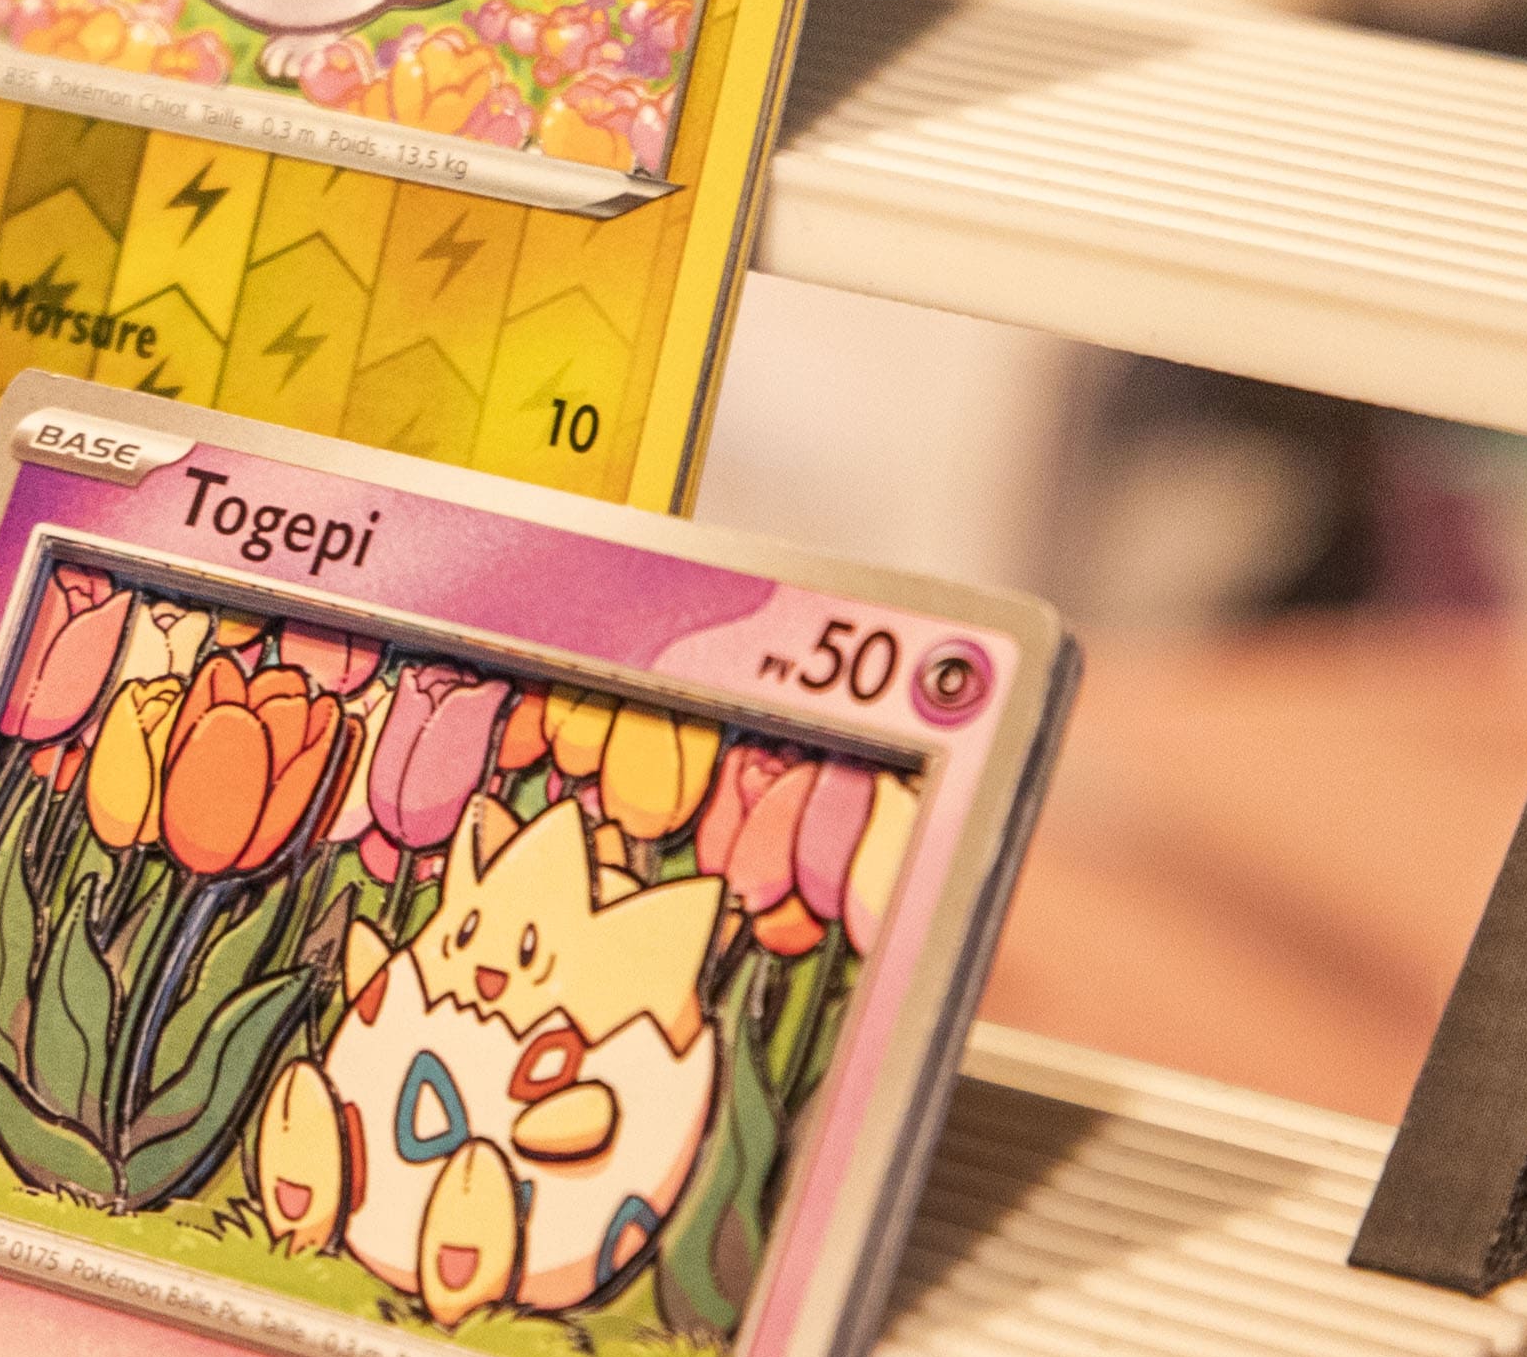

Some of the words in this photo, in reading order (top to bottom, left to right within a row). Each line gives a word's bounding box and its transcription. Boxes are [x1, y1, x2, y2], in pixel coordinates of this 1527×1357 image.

[51, 75, 132, 107] Pokémon
[139, 93, 188, 120] Chiot
[398, 143, 438, 171] 13,5
[443, 151, 469, 180] kg
[36, 424, 141, 466] BASE
[548, 398, 600, 454] 10
[184, 465, 381, 577] Togepi
[797, 618, 900, 703] 50
[9, 1239, 60, 1273] 0175
[70, 1257, 162, 1302] Pokémon
